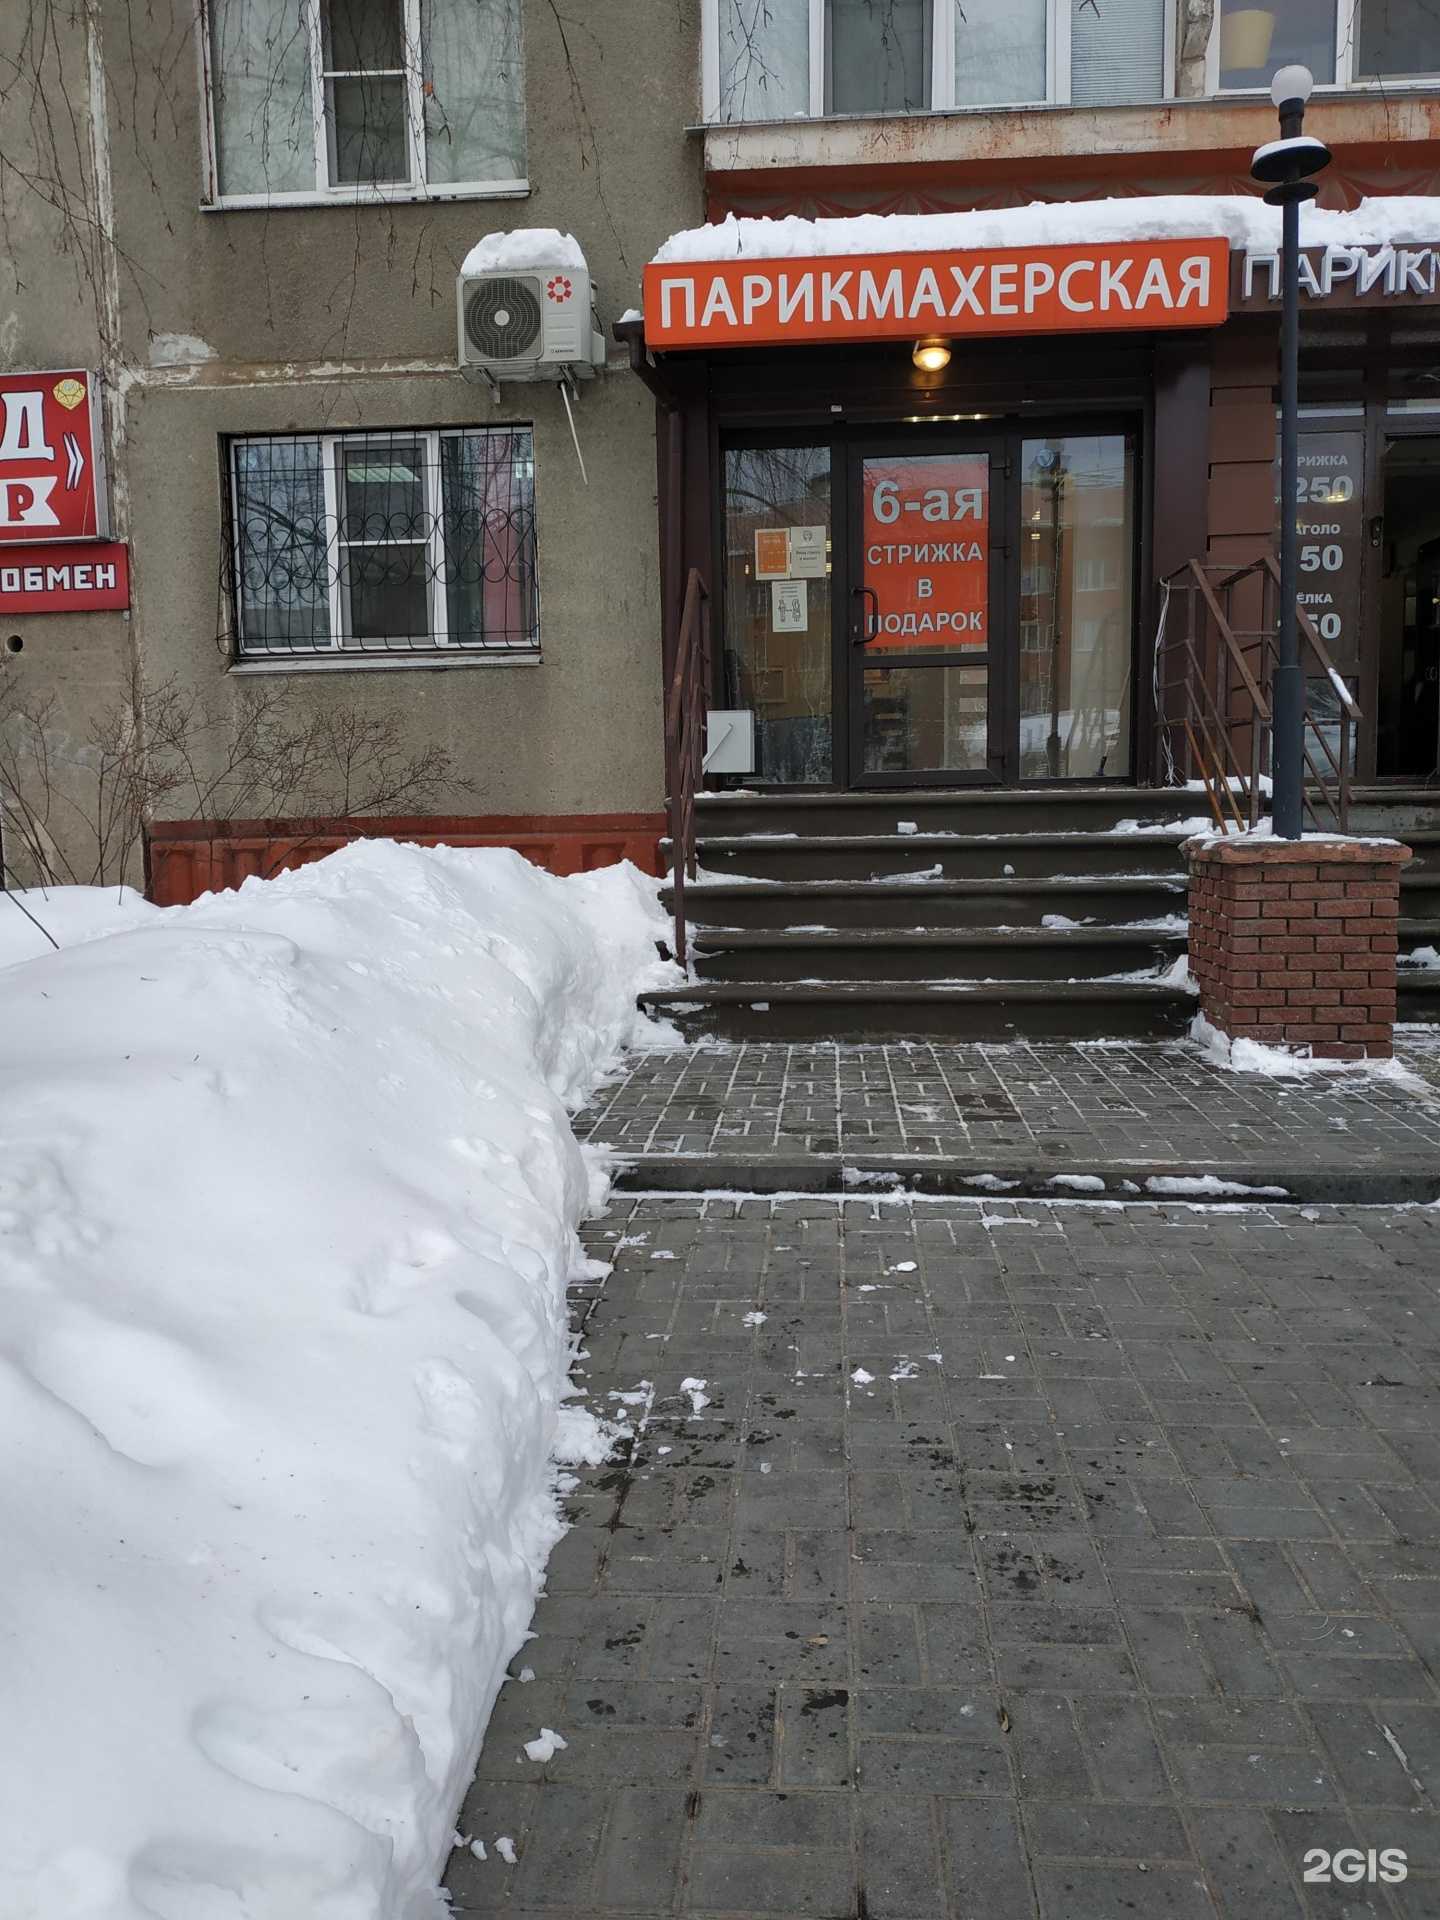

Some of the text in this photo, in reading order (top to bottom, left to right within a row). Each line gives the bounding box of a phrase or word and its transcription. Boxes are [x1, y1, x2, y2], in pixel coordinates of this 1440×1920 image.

[1243, 247, 1440, 299] ПАРИК
[660, 256, 1210, 328] ПАРИКМАХЕРСКАЯ
[1278, 455, 1348, 467] РИЖКА
[872, 480, 983, 524] 6-ая
[867, 543, 983, 565] СТРИЖКА
[1, 563, 117, 593] ОБМЕН
[917, 578, 933, 598] В
[1296, 592, 1333, 604] ЁЛКА
